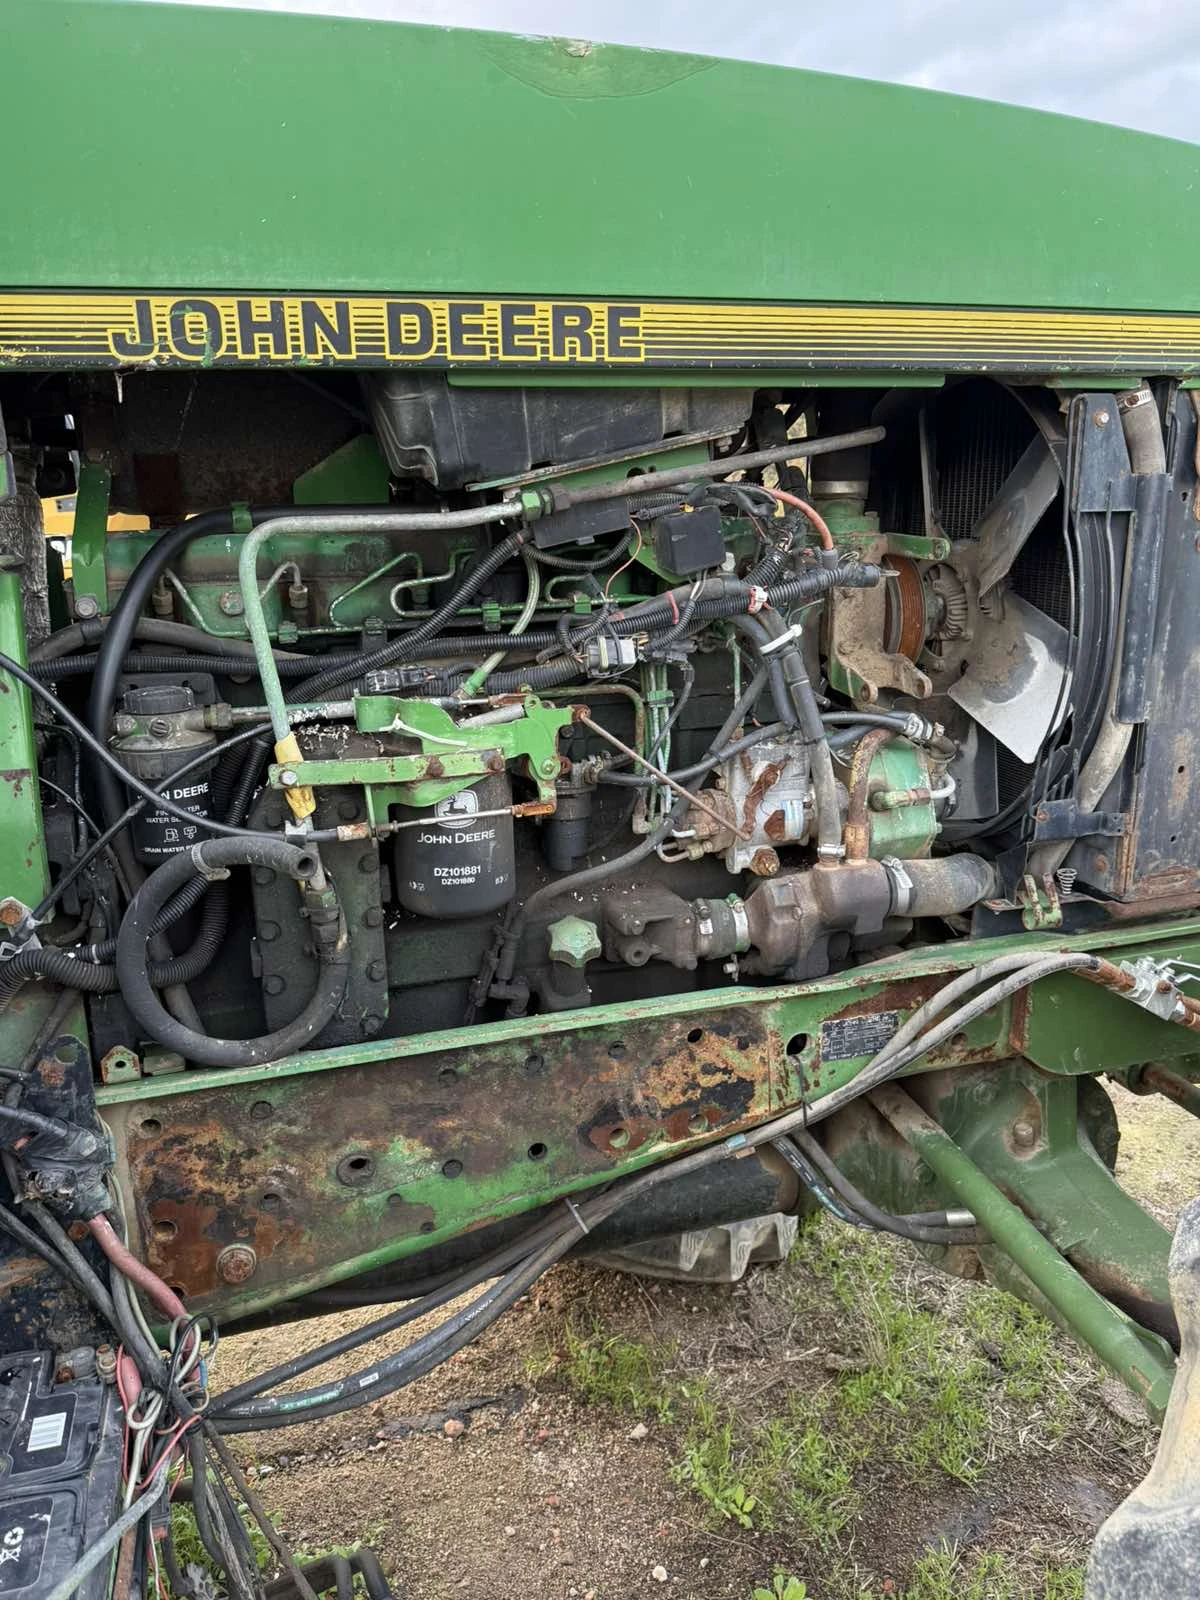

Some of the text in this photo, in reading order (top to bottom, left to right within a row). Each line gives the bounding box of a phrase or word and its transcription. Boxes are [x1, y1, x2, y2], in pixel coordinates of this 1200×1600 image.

[107, 298, 645, 362] JOHN DEERE
[173, 783, 208, 799] DEERE
[417, 829, 496, 844] JOHN DEERE
[434, 865, 481, 876] DZ101881
